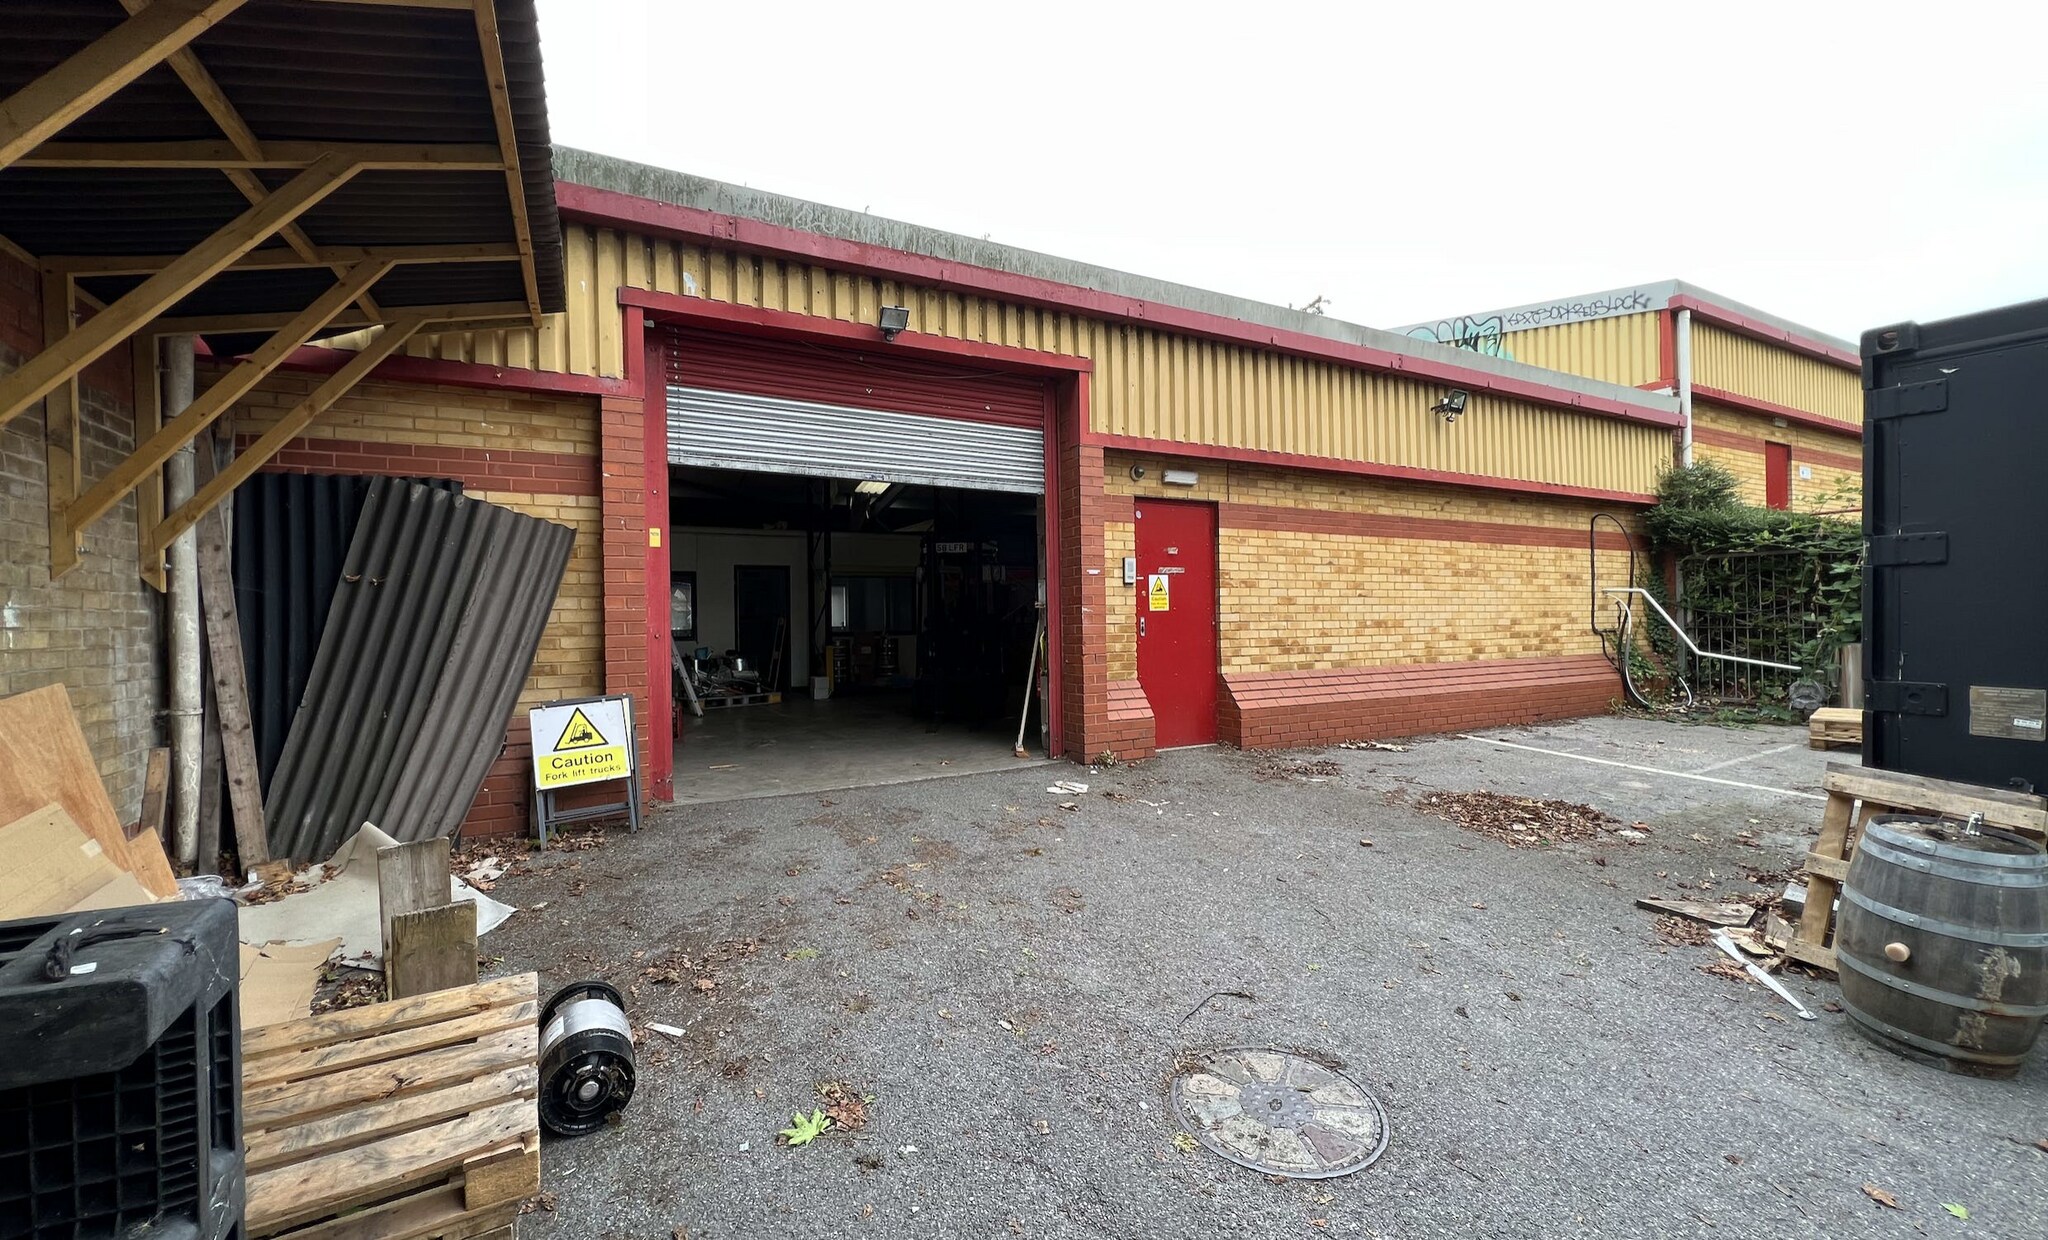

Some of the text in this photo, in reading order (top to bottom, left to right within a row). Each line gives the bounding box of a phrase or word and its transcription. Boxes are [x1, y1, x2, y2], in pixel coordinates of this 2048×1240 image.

[551, 753, 613, 769] Caution
[545, 765, 621, 781] Fork lift trucks
